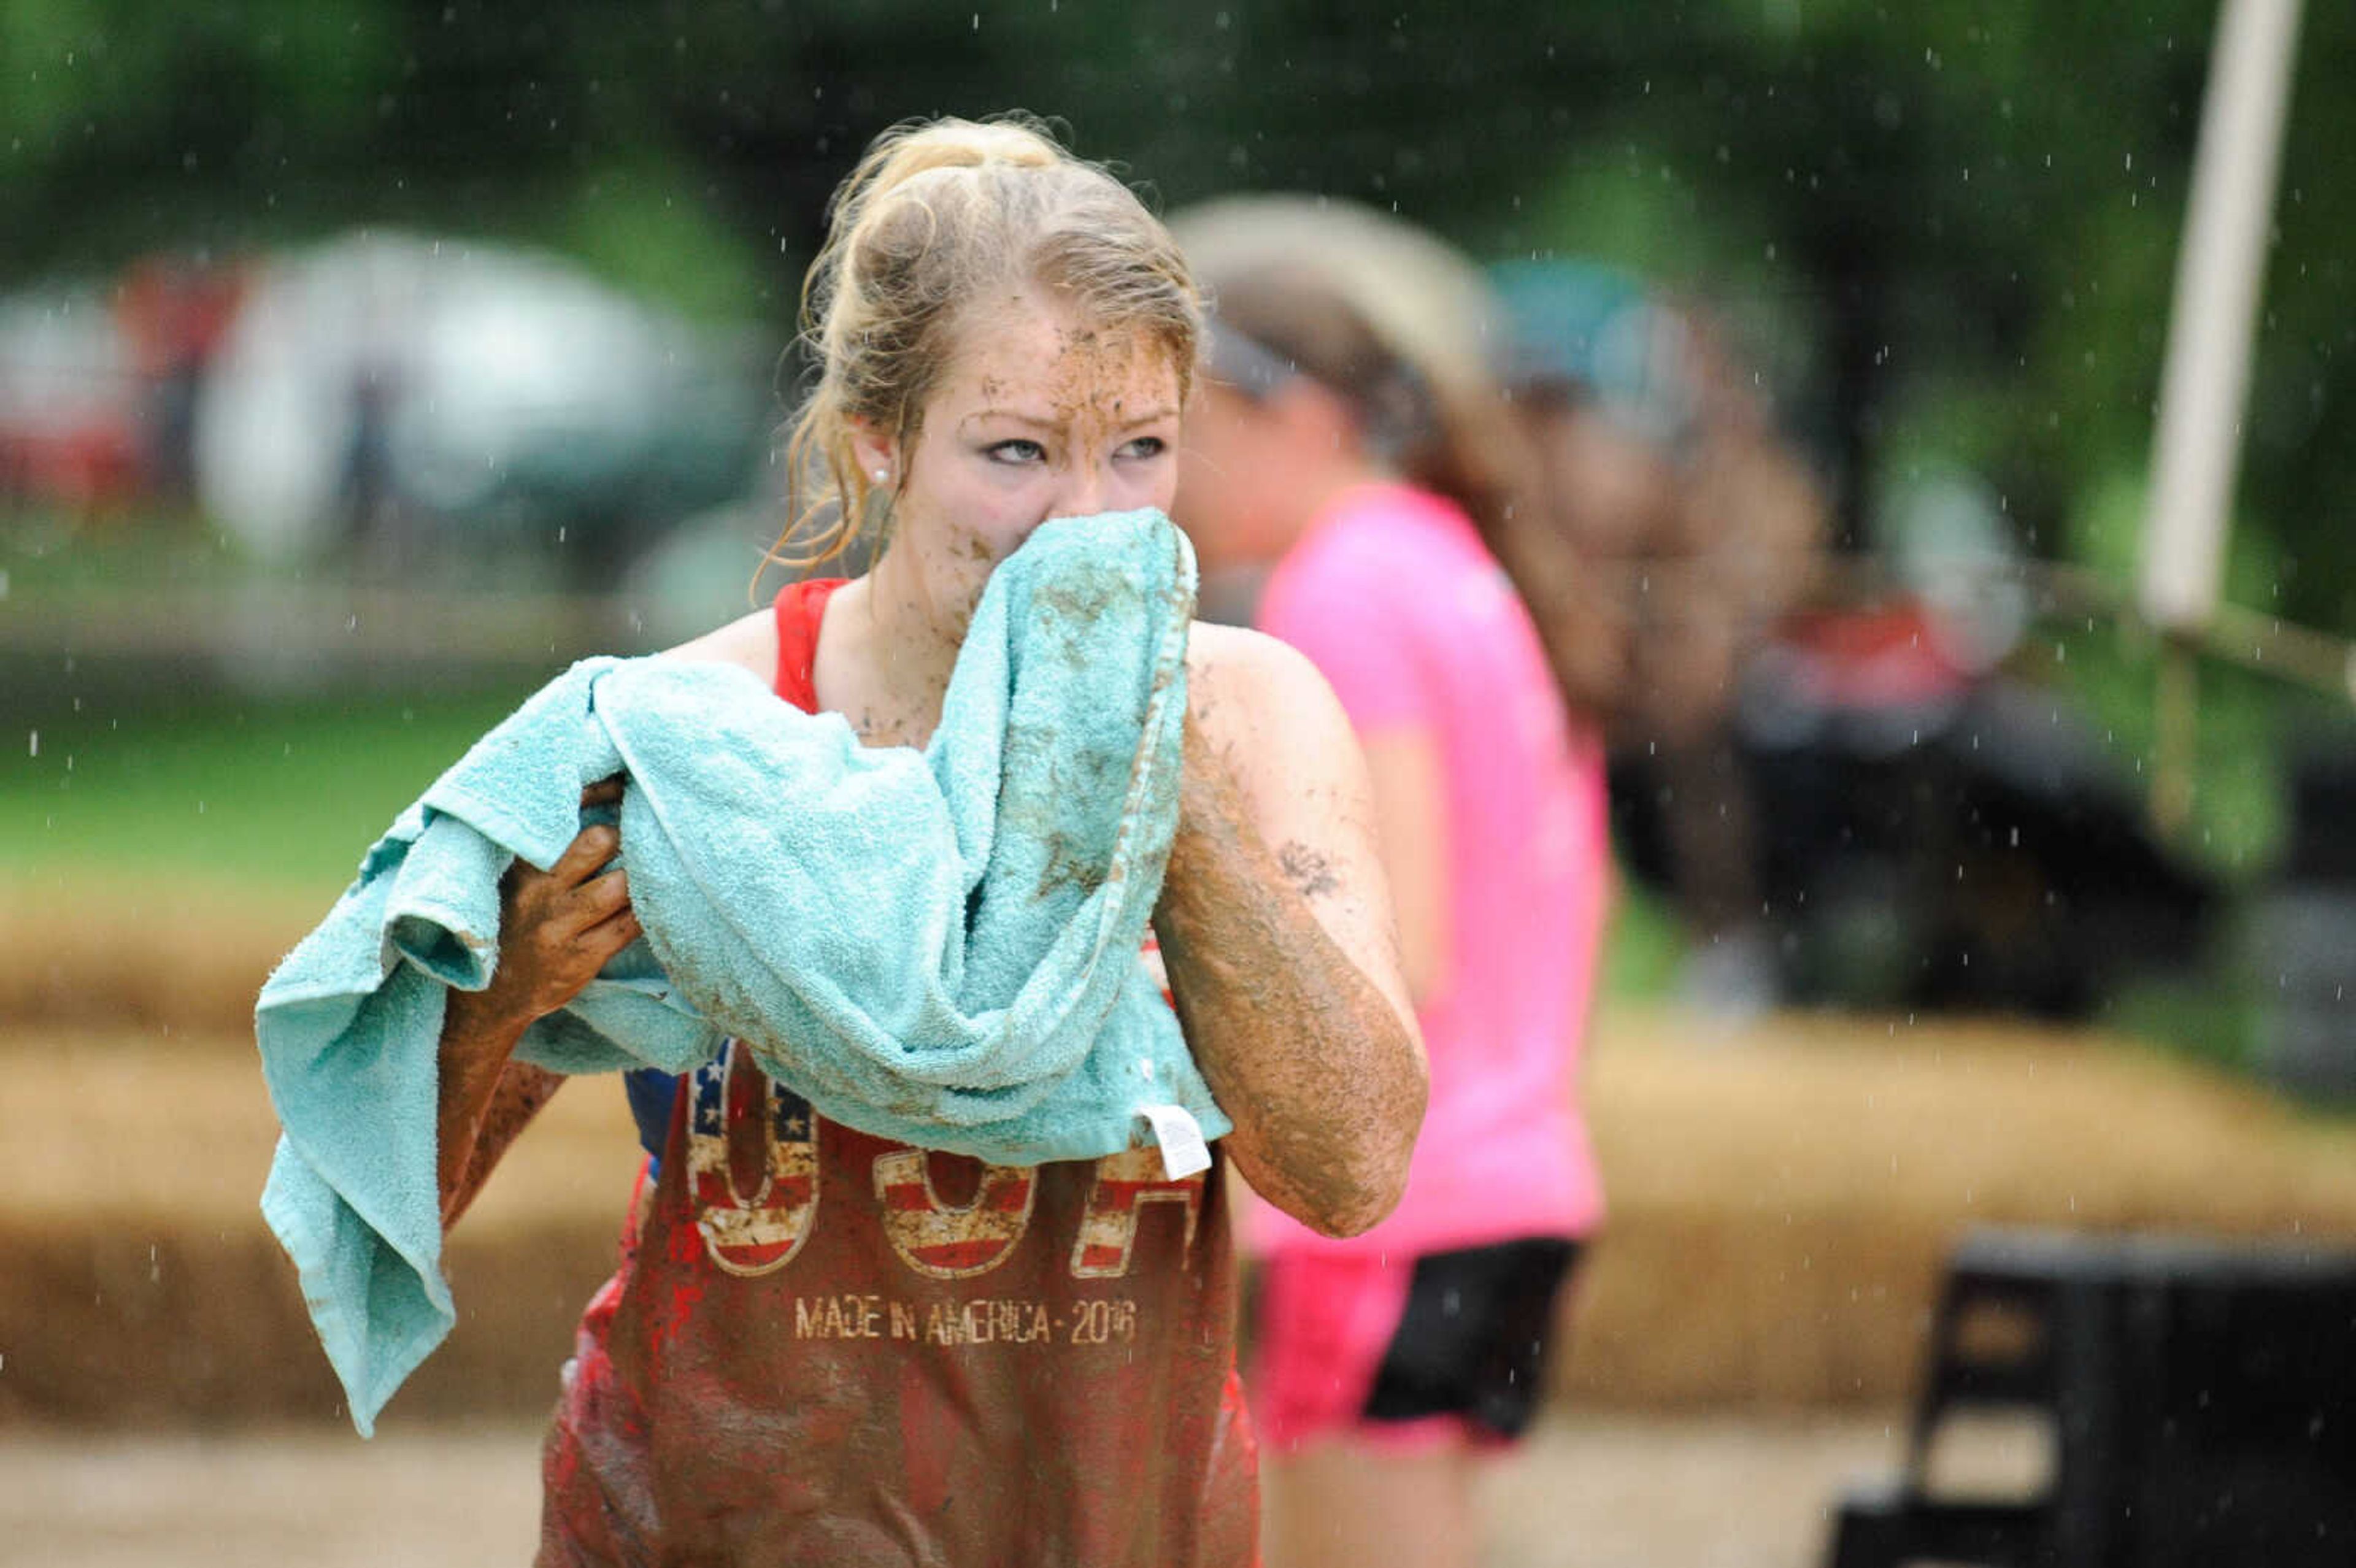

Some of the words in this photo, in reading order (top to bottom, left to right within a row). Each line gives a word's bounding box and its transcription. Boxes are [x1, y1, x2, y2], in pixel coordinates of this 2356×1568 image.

[796, 1294, 881, 1339] MADE
[890, 1301, 917, 1342] IN
[925, 1299, 1050, 1345] AMERICA
